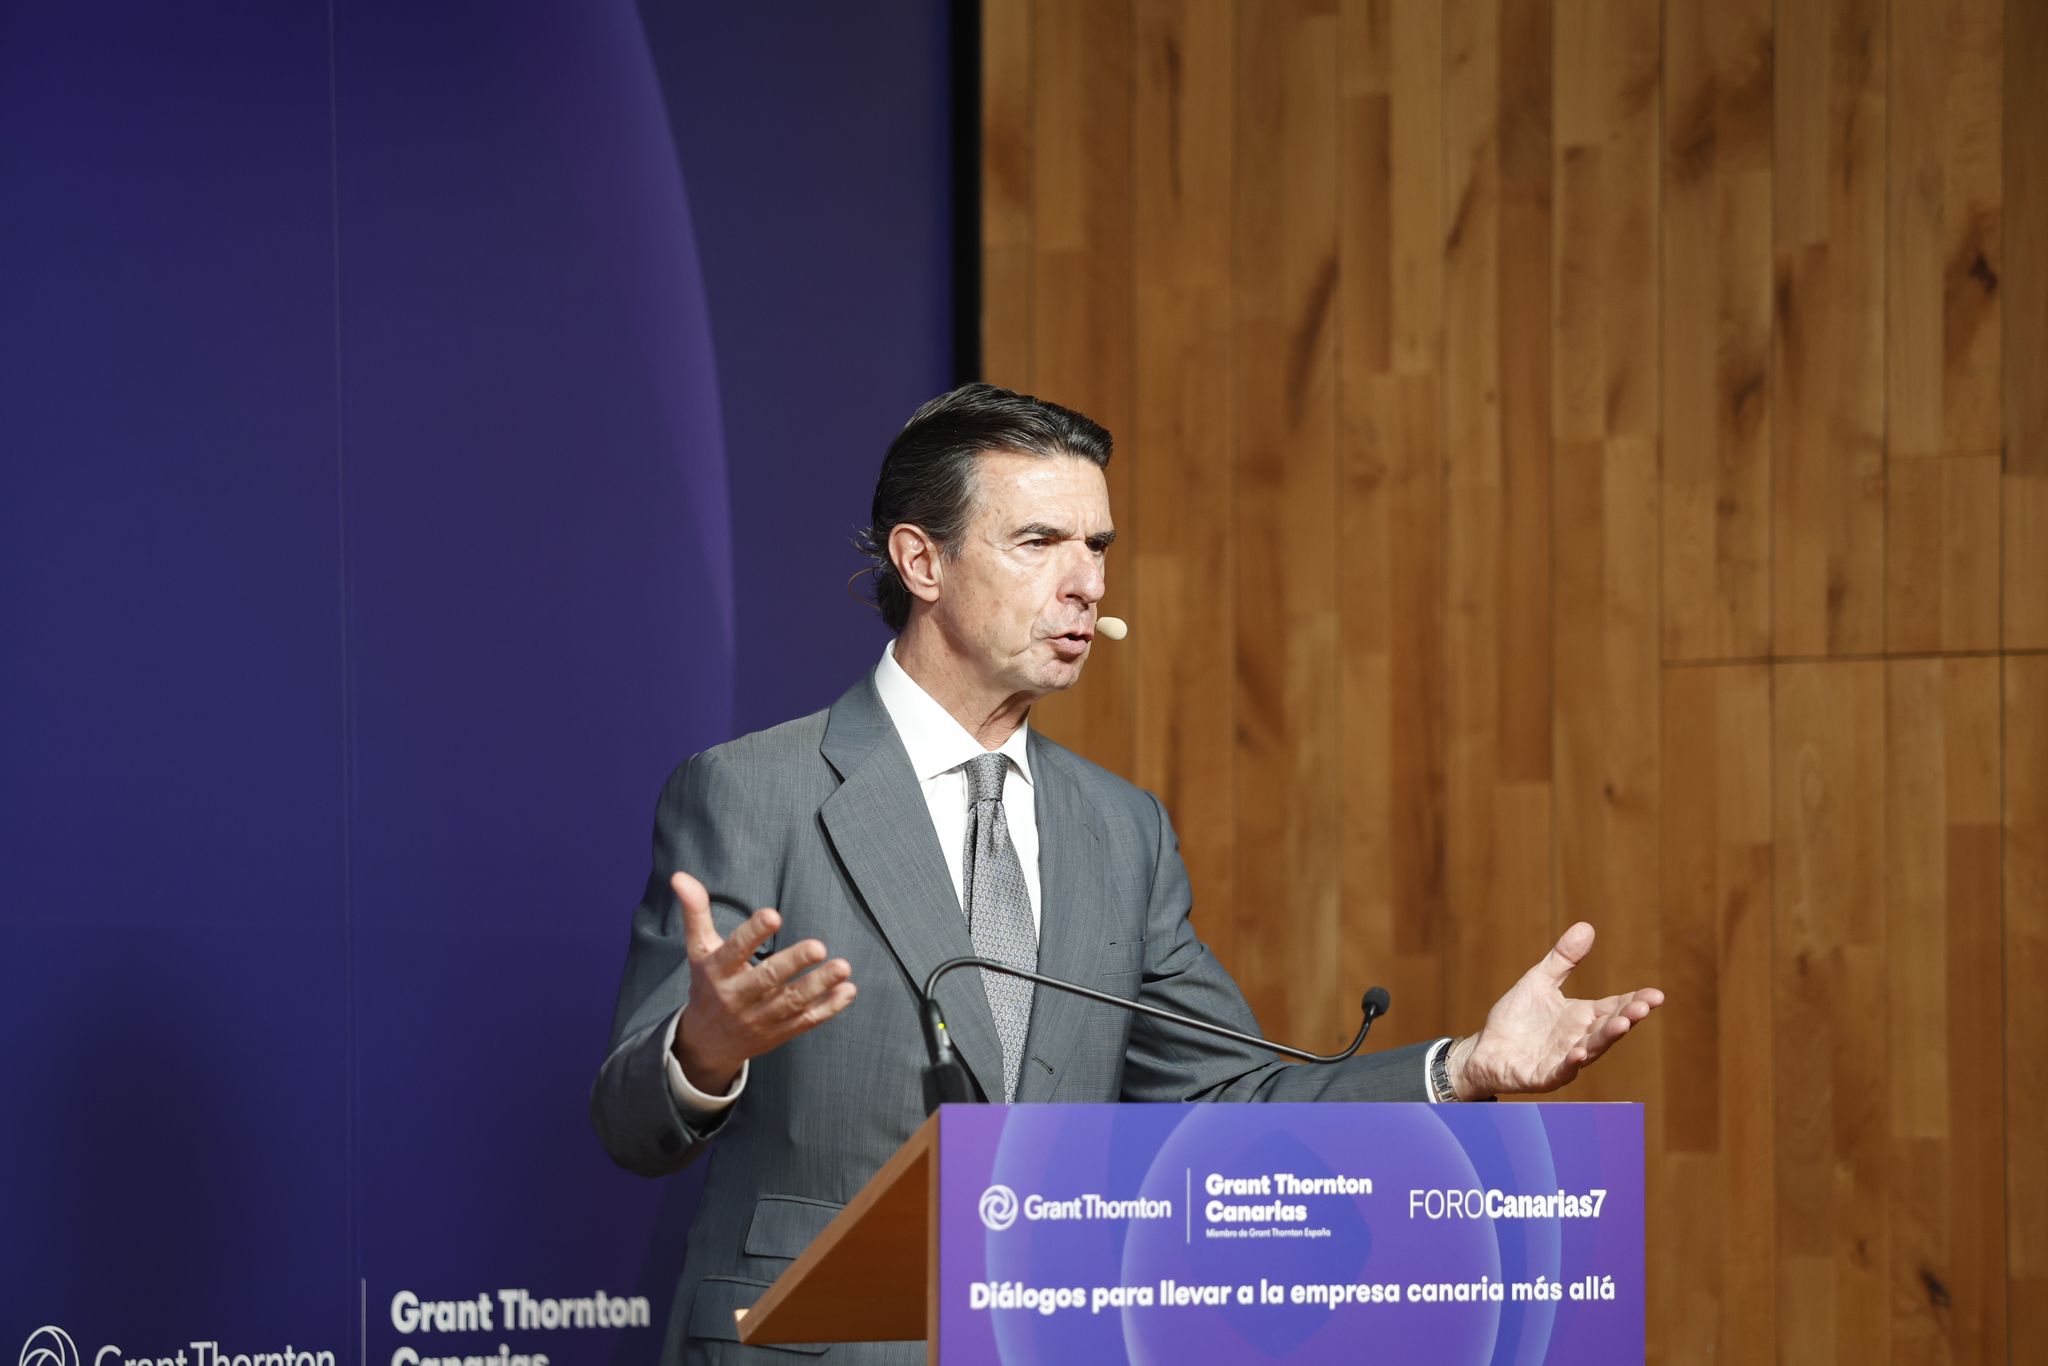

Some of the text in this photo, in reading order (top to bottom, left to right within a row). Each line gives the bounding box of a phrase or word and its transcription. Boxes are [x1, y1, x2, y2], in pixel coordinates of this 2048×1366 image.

[1205, 1172, 1373, 1197] Grant Thornton
[1205, 1199, 1308, 1223] Canarias
[1205, 1226, 1332, 1239] Miembro de Grant Thornton España
[969, 1273, 1615, 1316] Diálogos para llevar a la empresa canaria más allá
[391, 1288, 651, 1334] Grant Thornton
